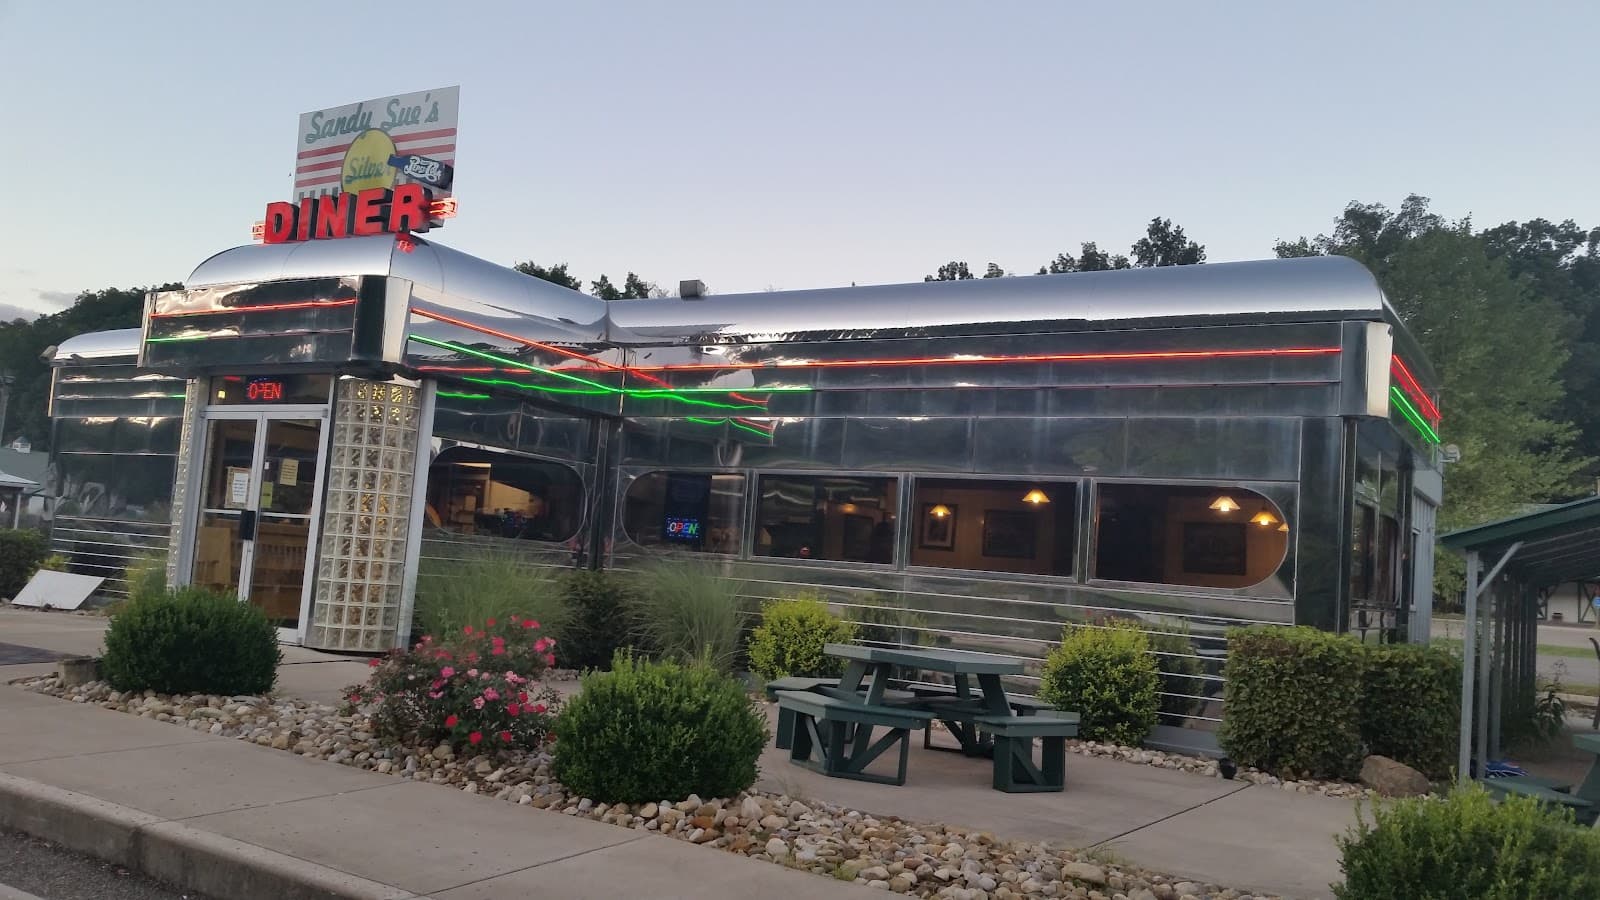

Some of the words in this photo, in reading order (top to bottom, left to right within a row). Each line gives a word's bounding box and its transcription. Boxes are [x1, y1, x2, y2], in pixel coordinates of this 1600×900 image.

[305, 102, 372, 143] Sandy
[380, 93, 440, 129] Sue's
[344, 156, 389, 184] Silve
[264, 182, 427, 244] DINER
[249, 383, 281, 399] OPEN
[670, 522, 697, 534] OPEN
